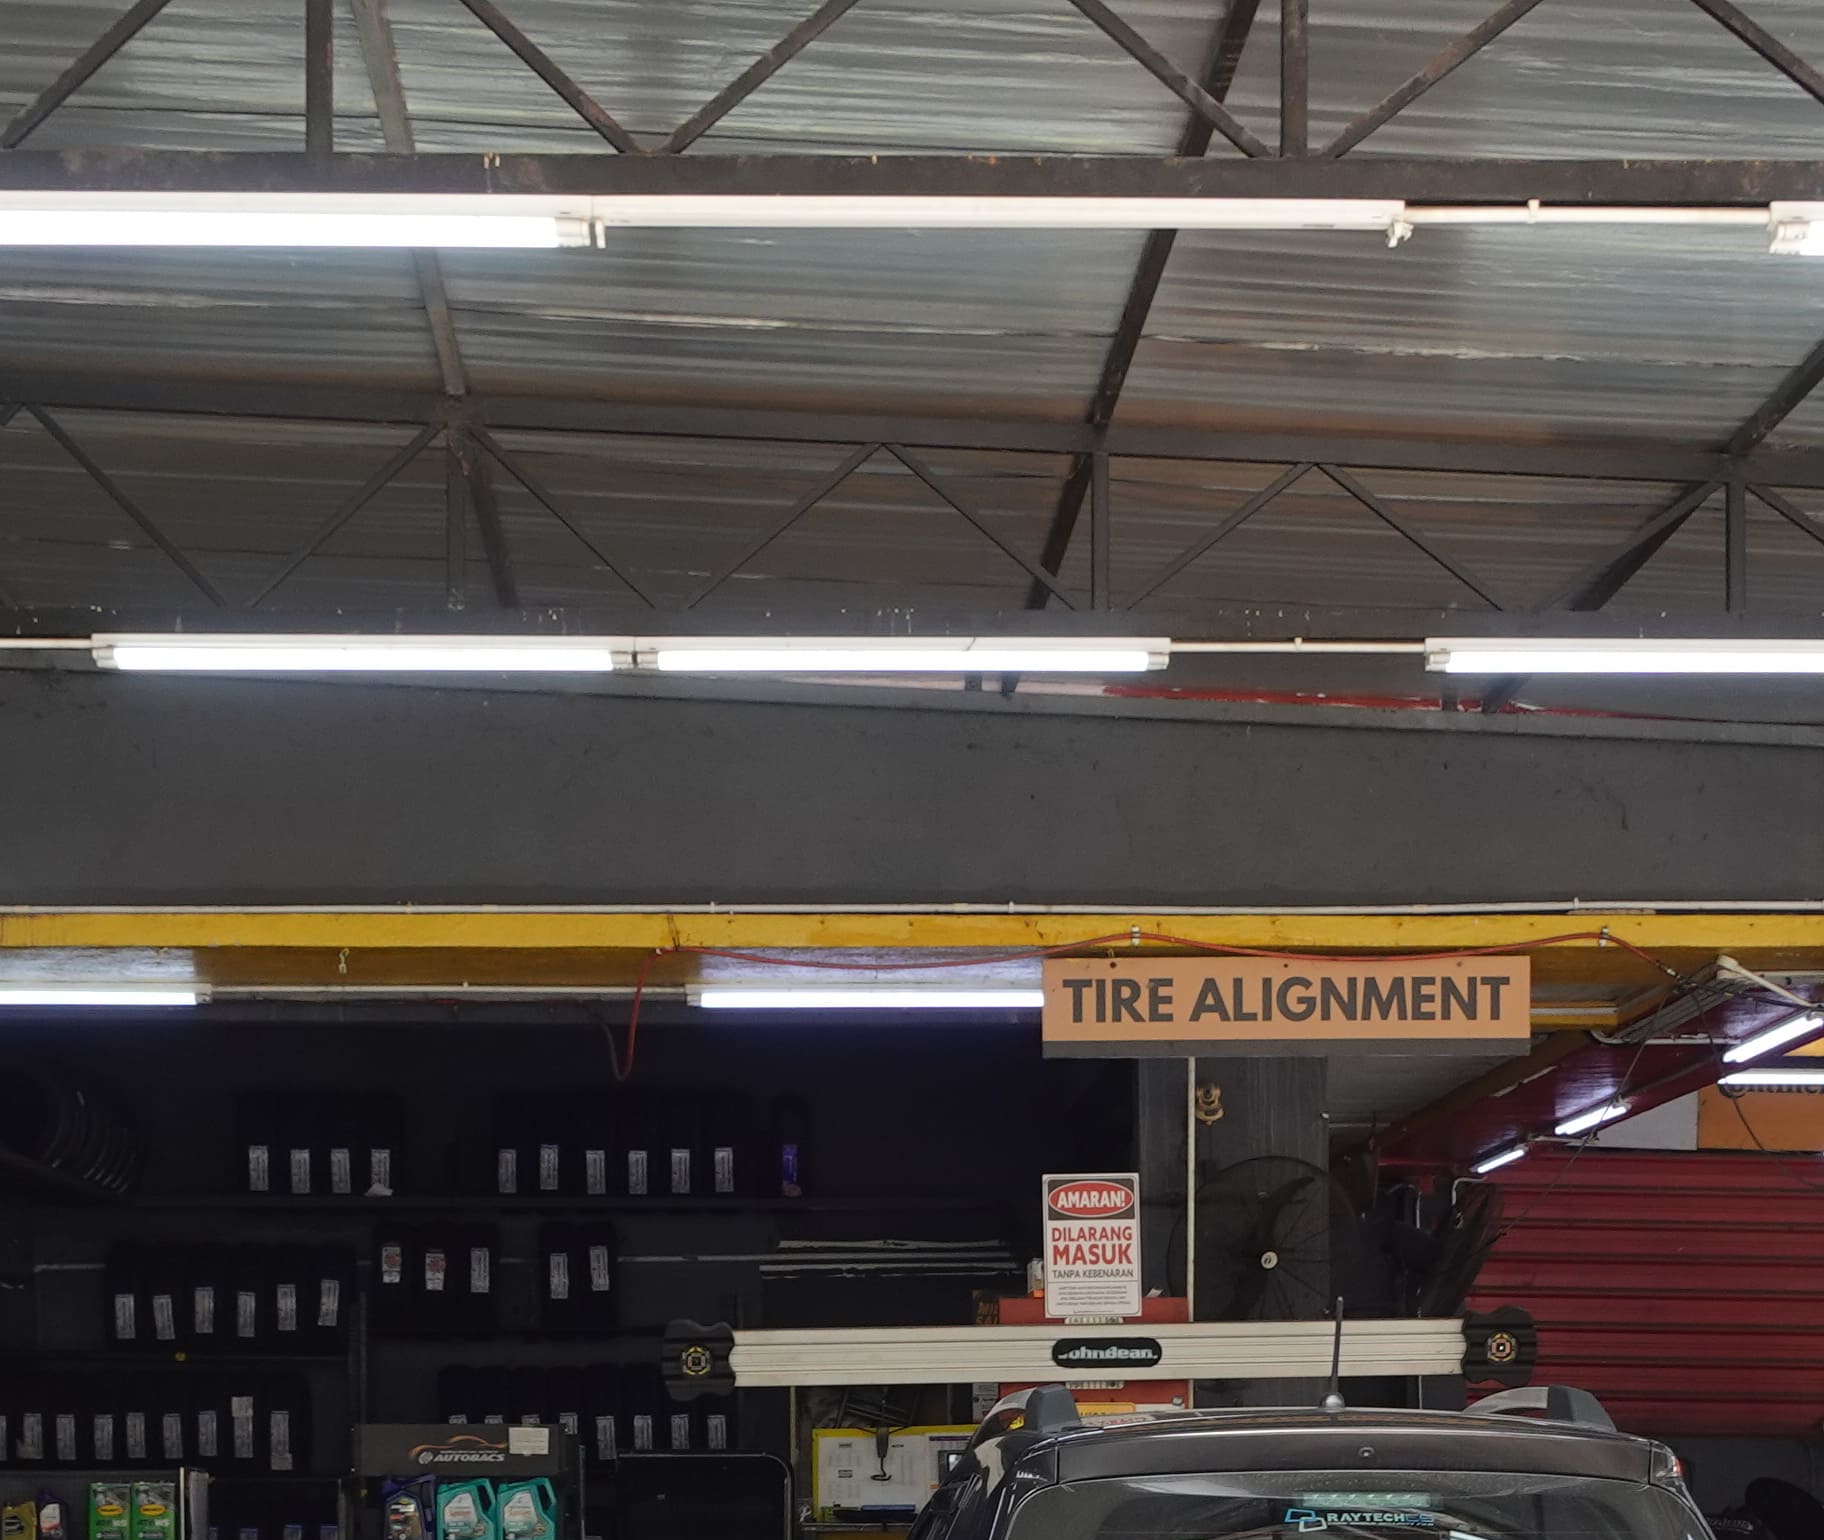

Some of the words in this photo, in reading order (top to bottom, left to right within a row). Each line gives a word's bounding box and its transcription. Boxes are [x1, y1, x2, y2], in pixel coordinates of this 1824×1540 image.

[1062, 977, 1175, 1024] TIRE
[1189, 973, 1511, 1023] ALIGNMENT
[1056, 1189, 1126, 1209] AMARAN!
[1051, 1225, 1133, 1242] DILARANG
[1052, 1243, 1133, 1266] MASUK
[1052, 1269, 1080, 1279] TANPA
[1082, 1268, 1134, 1279] KEBENARAN
[433, 1453, 505, 1463] AUTOBACS
